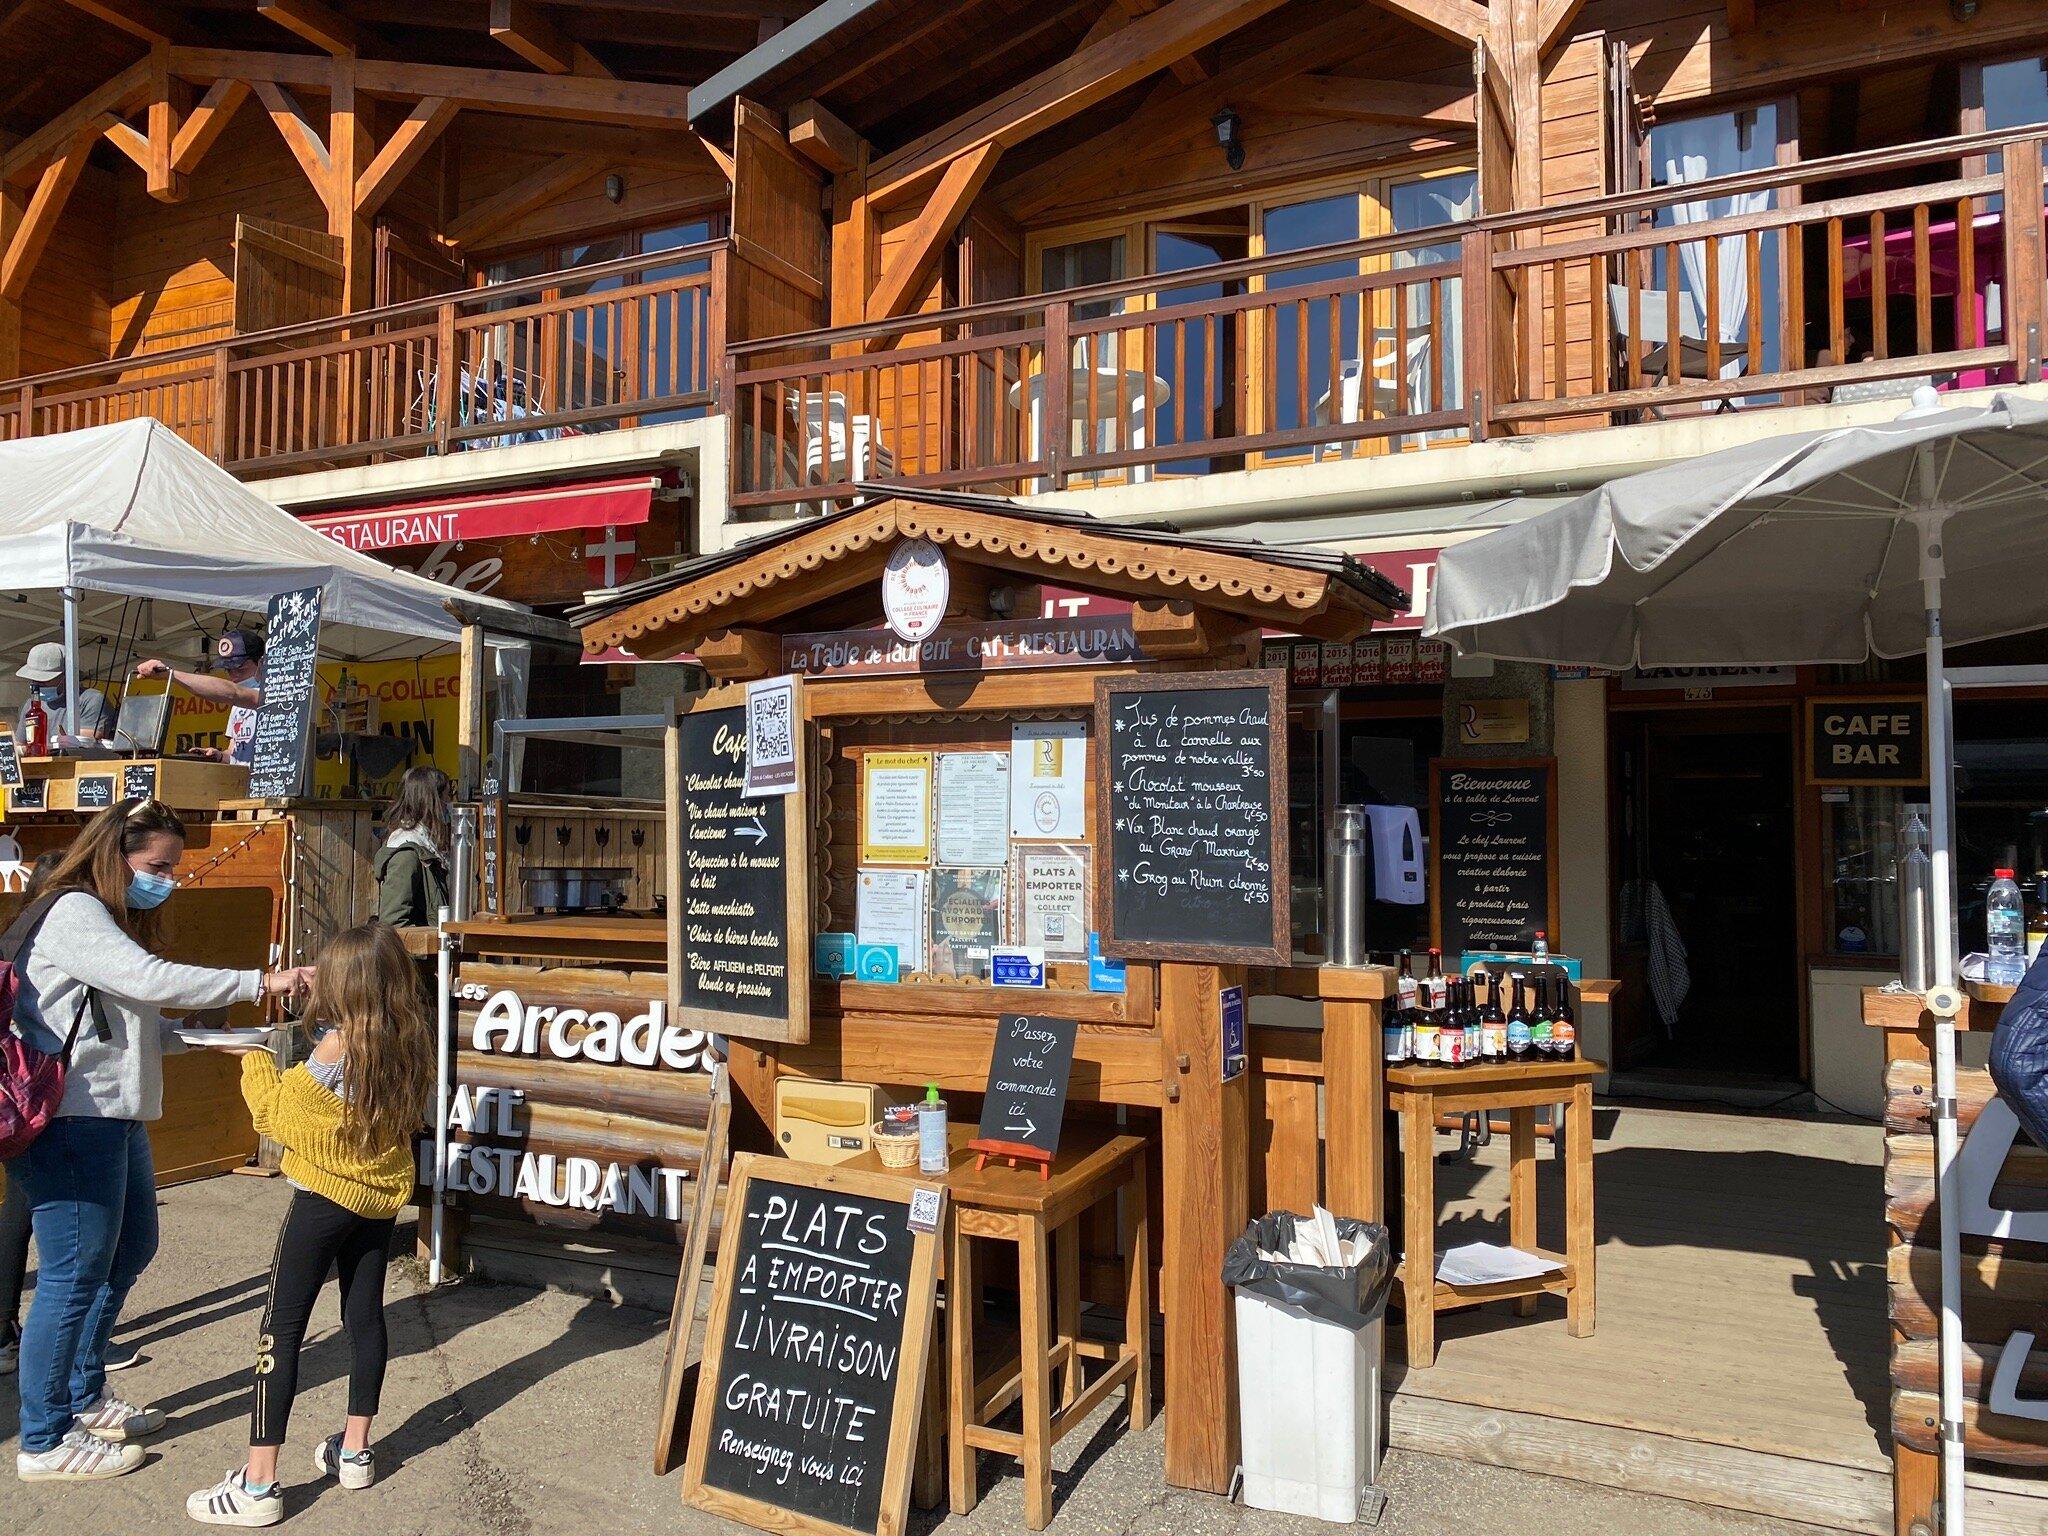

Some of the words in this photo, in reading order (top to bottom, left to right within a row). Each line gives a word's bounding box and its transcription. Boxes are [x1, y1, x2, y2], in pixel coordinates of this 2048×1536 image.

[791, 650, 807, 668] La
[811, 641, 859, 667] Table
[865, 645, 882, 665] de
[1266, 652, 1288, 662] 2013
[1295, 650, 1317, 660] 2014
[1326, 649, 1348, 659] 2015
[1356, 648, 1380, 658] 2016
[1388, 645, 1411, 655] 2017
[1419, 644, 1442, 654] 2018
[1125, 696, 1157, 732] Jus
[1165, 705, 1179, 728] de
[1182, 715, 1236, 731] pommes
[1239, 707, 1270, 726] Chaud
[1824, 714, 1911, 735] CAFE
[1134, 732, 1146, 748] à
[1156, 728, 1171, 748] la
[1181, 730, 1232, 747] cannelle
[1240, 737, 1262, 746] aux
[1121, 753, 1167, 771] pommes
[1174, 750, 1186, 765] de
[1190, 751, 1219, 764] notre
[1222, 750, 1255, 766] vallée
[1832, 744, 1900, 764] BAR
[688, 774, 722, 791] Chocolat
[723, 771, 745, 789] chau
[1128, 766, 1186, 792] Chocolat
[1451, 773, 1532, 791] Bienvenue
[1196, 799, 1203, 809] à
[1204, 797, 1212, 809] la
[1215, 794, 1262, 810] Chartreuse
[1453, 794, 1463, 803] la
[1465, 794, 1487, 803] table
[1490, 794, 1500, 803] de
[1502, 793, 1539, 803] Laurent
[688, 803, 702, 820] Vin
[704, 802, 728, 819] chaud
[729, 803, 757, 818] maison
[759, 802, 766, 816] à
[1126, 813, 1145, 835] Vin
[1149, 815, 1184, 838] Blanc
[1188, 820, 1218, 836] chaud
[1224, 825, 1261, 845] orangé
[1139, 843, 1154, 853] au
[1159, 838, 1199, 859] Grand
[1203, 840, 1253, 858] Marnier
[1457, 835, 1470, 845] Le
[1472, 835, 1489, 847] chef
[1490, 835, 1527, 845] Laurent
[689, 850, 729, 872] Capuccino
[731, 854, 737, 867] à
[739, 852, 748, 868] la
[750, 856, 780, 868] mousse
[1463, 853, 1496, 862] propose
[1499, 853, 1509, 861] sa
[1512, 852, 1541, 861] cuisine
[1033, 868, 1065, 876] PLATS
[1133, 861, 1168, 896] Grog
[1171, 876, 1186, 885] au
[1190, 869, 1223, 890] Rhum
[1228, 872, 1268, 891] citronné
[1457, 867, 1491, 876] créative
[1492, 866, 1527, 877] élaborée
[690, 874, 700, 888] de
[701, 874, 717, 889] lait
[1026, 881, 1082, 890] EMPORTER
[1474, 884, 1480, 892] à
[1483, 884, 1510, 894] partir
[687, 901, 710, 915] Latte
[1457, 899, 1466, 907] de
[1468, 899, 1505, 910] produits
[1506, 899, 1529, 912] frais
[1461, 915, 1525, 927] rigoureusement
[689, 925, 712, 942] Choix
[714, 927, 724, 943] de
[725, 927, 749, 945] bières
[750, 927, 779, 948] locales
[690, 952, 711, 970] Bière
[713, 960, 746, 974] AFFLIGEM
[746, 965, 754, 975] et
[754, 964, 785, 978] PELFORT
[698, 973, 724, 991] blonde
[725, 981, 735, 993] en
[736, 981, 772, 998] pression
[472, 989, 728, 1074] Arcades
[1010, 1016, 1058, 1054] Passez
[1012, 1055, 1044, 1070] votre
[995, 1076, 1057, 1098] commande
[1009, 1101, 1026, 1117] ici
[741, 1254, 757, 1283] A
[767, 1257, 903, 1318] EMPORTER
[734, 1304, 897, 1381] LIVRAISON
[725, 1373, 876, 1442] GRATUITE
[719, 1428, 793, 1485] Renseignez
[801, 1458, 834, 1482] vous
[839, 1457, 867, 1487] ici
